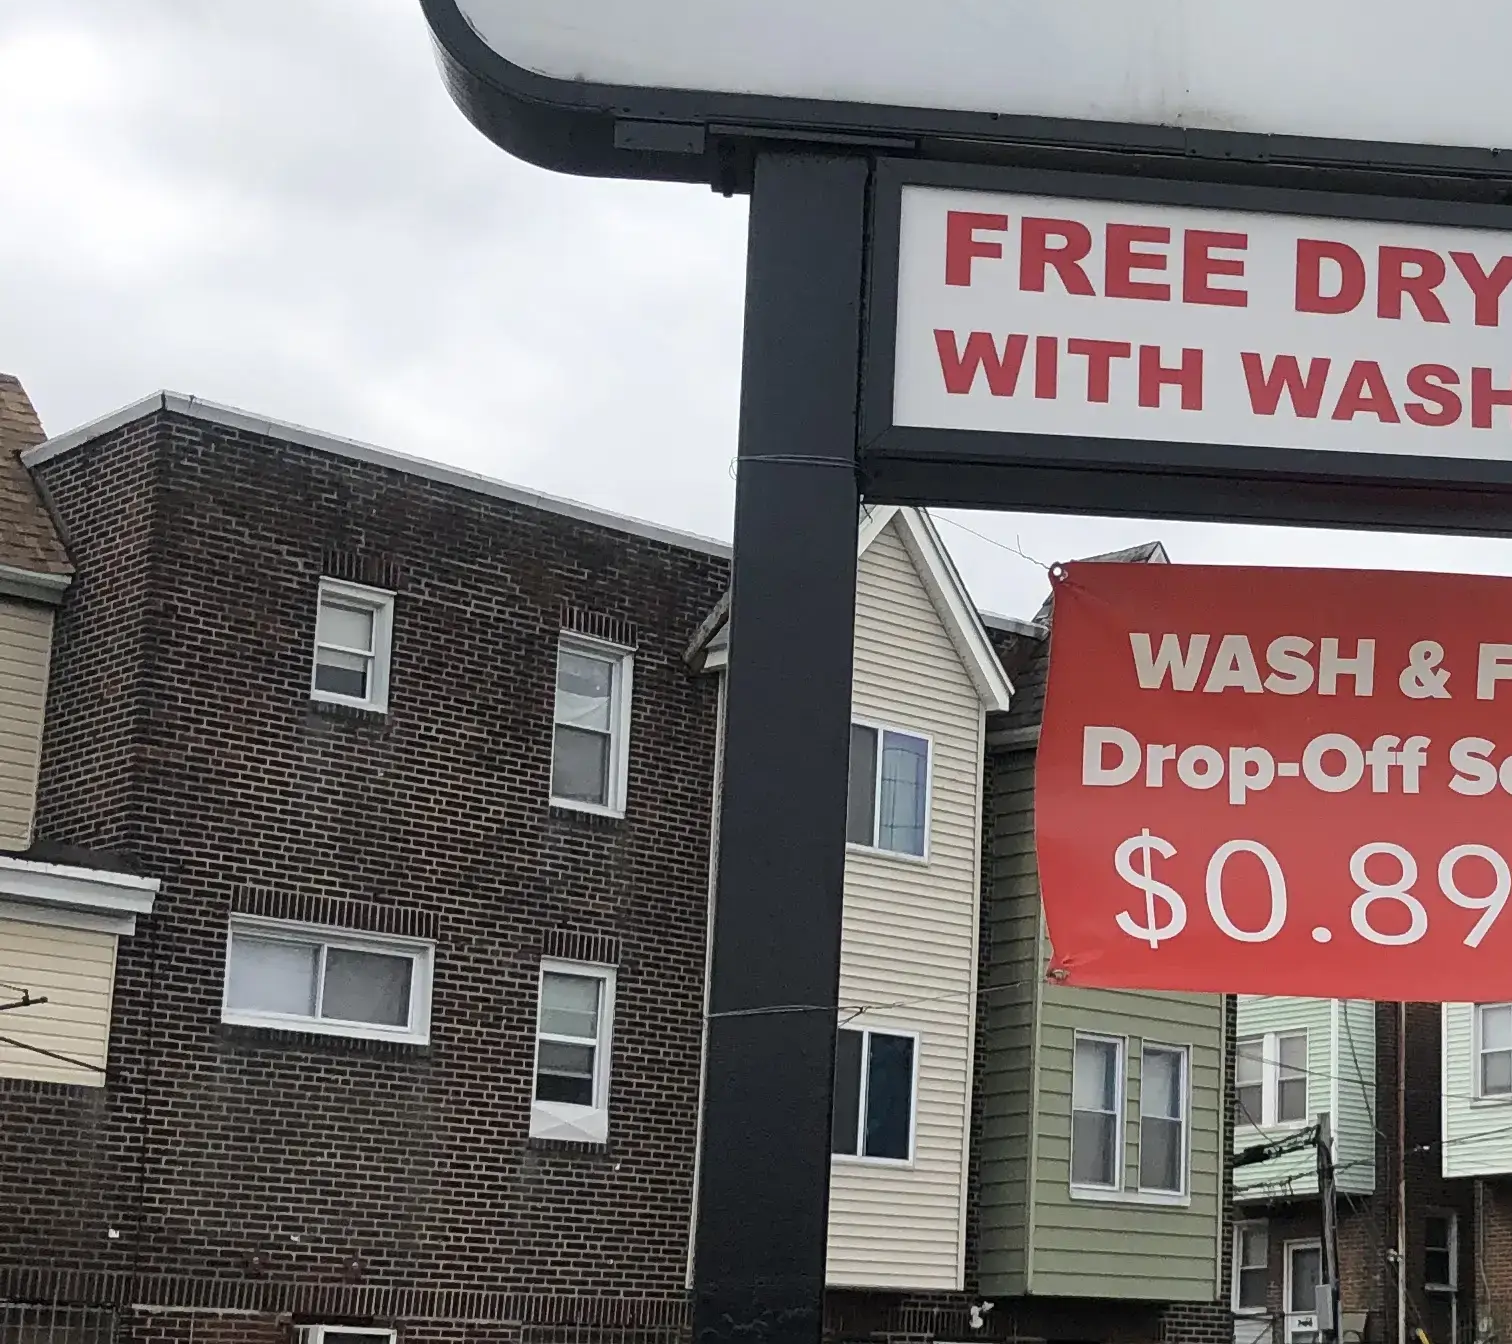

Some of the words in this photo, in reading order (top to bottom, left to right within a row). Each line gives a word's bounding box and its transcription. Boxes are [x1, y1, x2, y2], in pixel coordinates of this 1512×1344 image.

[944, 211, 1249, 308] FREE
[933, 329, 1205, 412] WITH
[1128, 632, 1377, 698] WASH
[1399, 640, 1453, 700] &
[1082, 726, 1433, 806] Drop-Off
